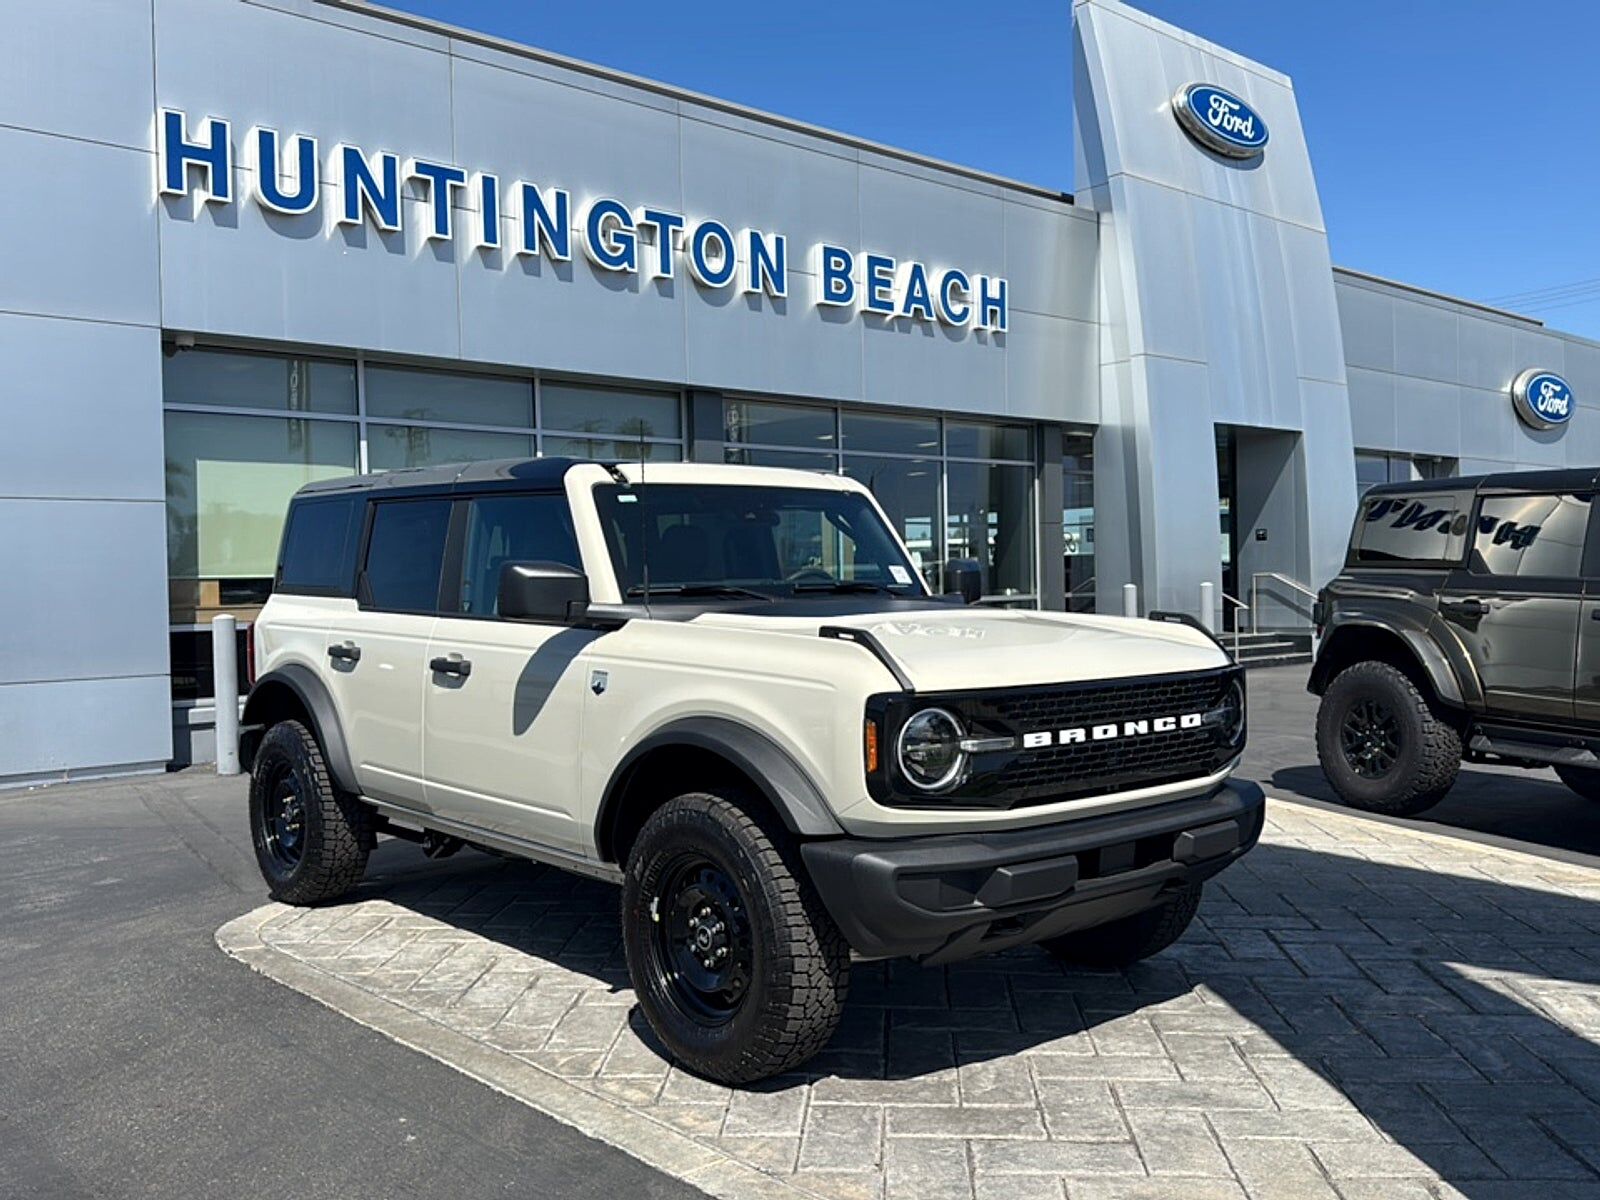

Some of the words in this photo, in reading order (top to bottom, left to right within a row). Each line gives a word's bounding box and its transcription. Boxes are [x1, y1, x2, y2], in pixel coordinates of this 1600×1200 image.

[1208, 94, 1255, 139] Ford
[159, 107, 787, 297] HUNTINGTON
[817, 242, 1008, 332] BEACH
[1538, 381, 1570, 415] Ford
[1023, 713, 1202, 748] BRONCO
